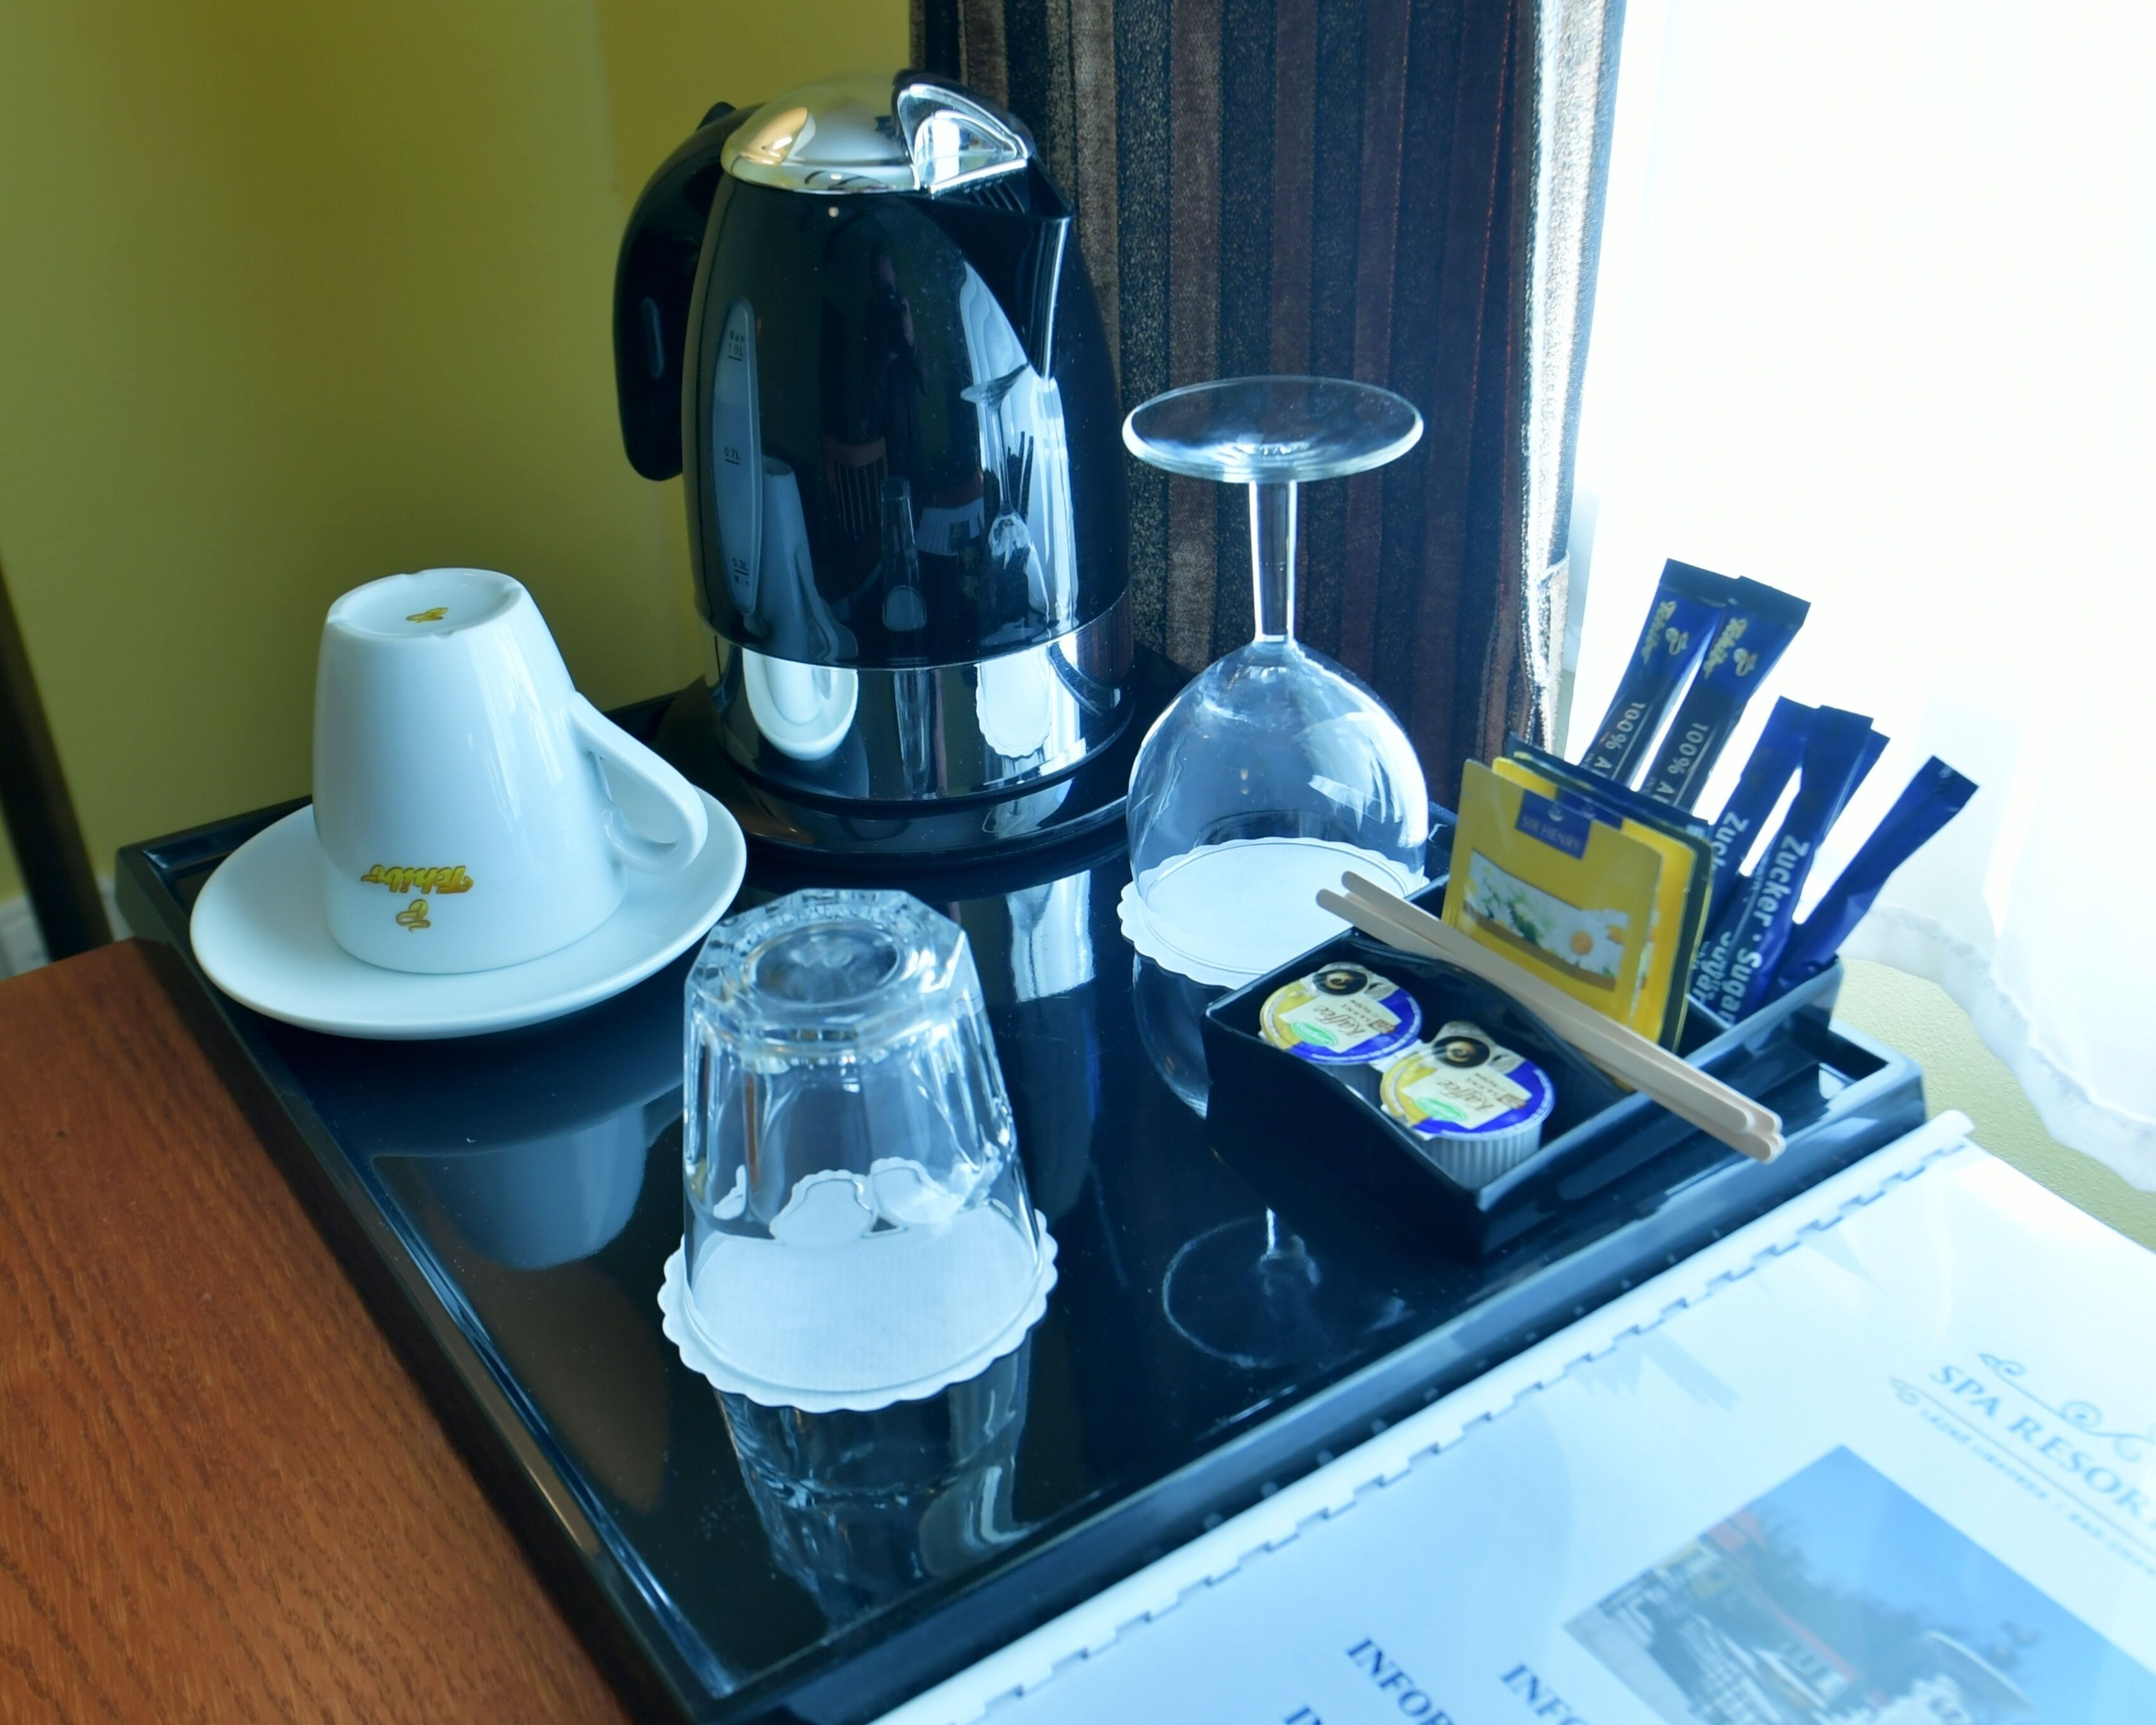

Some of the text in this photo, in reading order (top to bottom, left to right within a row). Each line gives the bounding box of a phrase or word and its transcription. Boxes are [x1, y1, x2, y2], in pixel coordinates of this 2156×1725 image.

[1604, 702, 1647, 751] 100%
[1667, 721, 1710, 775] 100%
[360, 864, 474, 895] Tchibo
[1717, 834, 1811, 1026] Zucker Sugar
[1929, 1364, 2001, 1418] SPA
[2007, 1414, 2156, 1529] RESOR
[1498, 1662, 1590, 1725] INF
